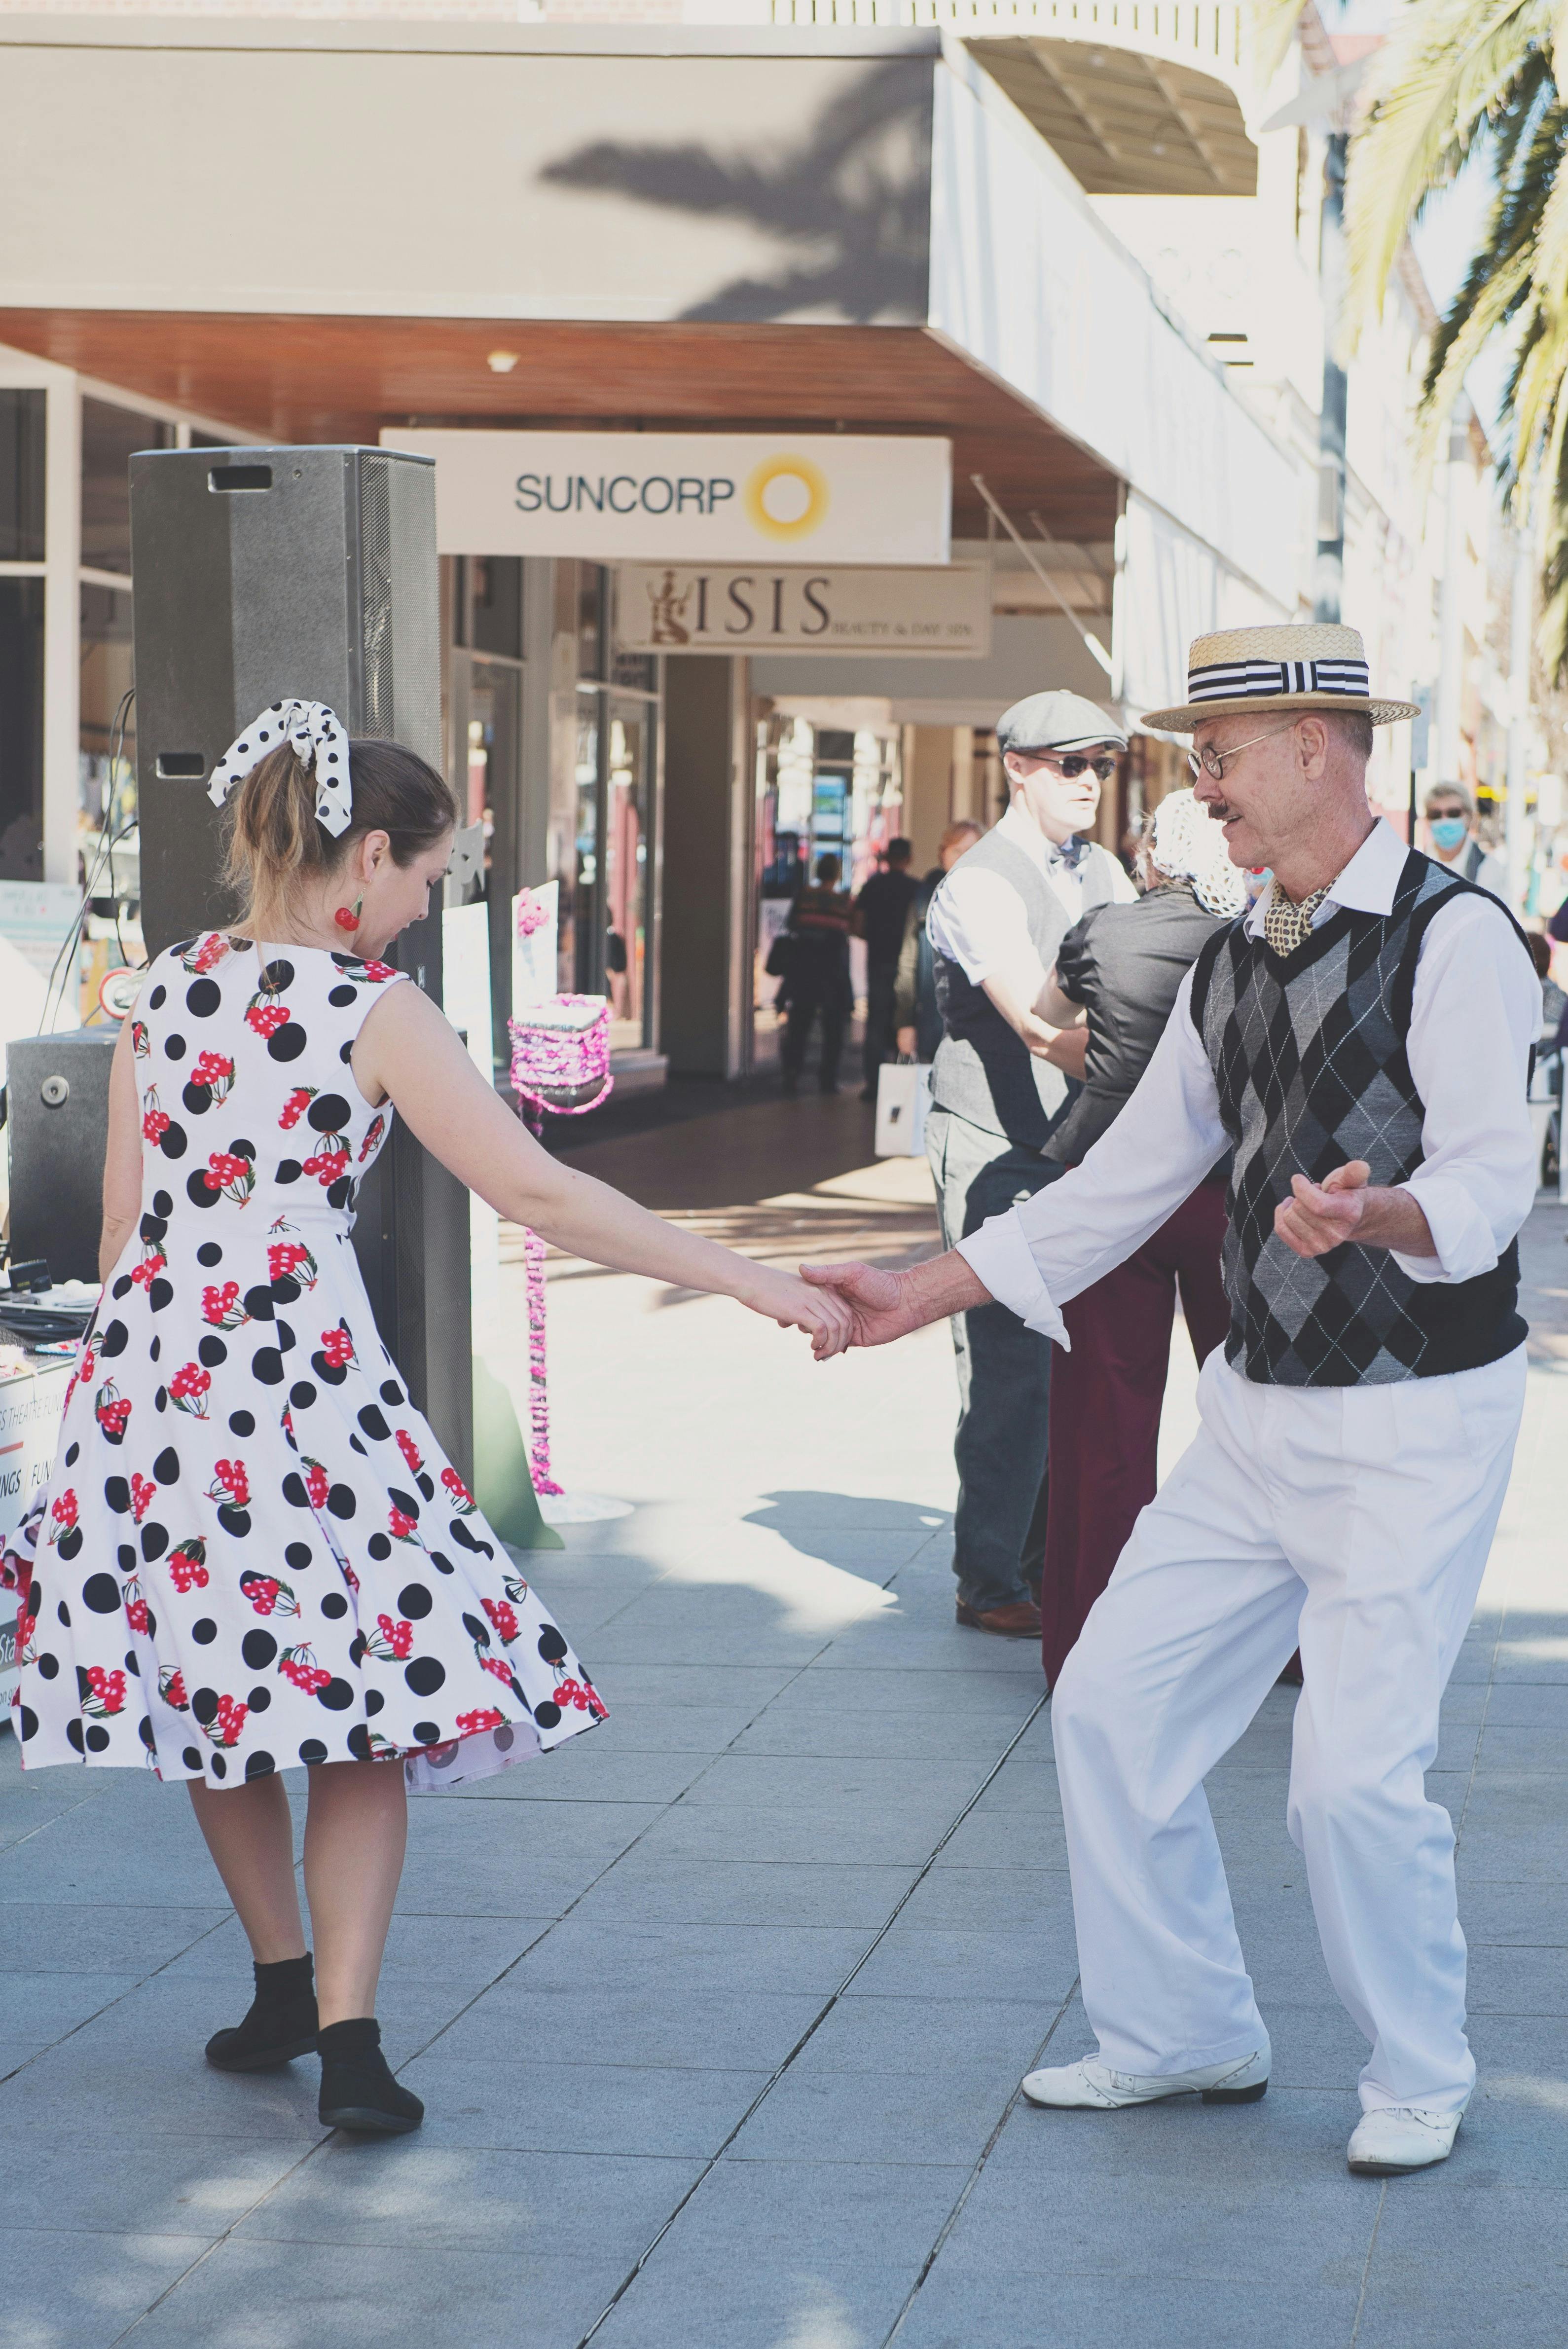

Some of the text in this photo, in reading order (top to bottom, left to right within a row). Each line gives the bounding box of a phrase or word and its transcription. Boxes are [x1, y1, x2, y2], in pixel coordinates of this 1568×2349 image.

[514, 474, 735, 514] SUNCORP
[695, 576, 831, 635] ISIS
[8, 1397, 42, 1429] THEATRE
